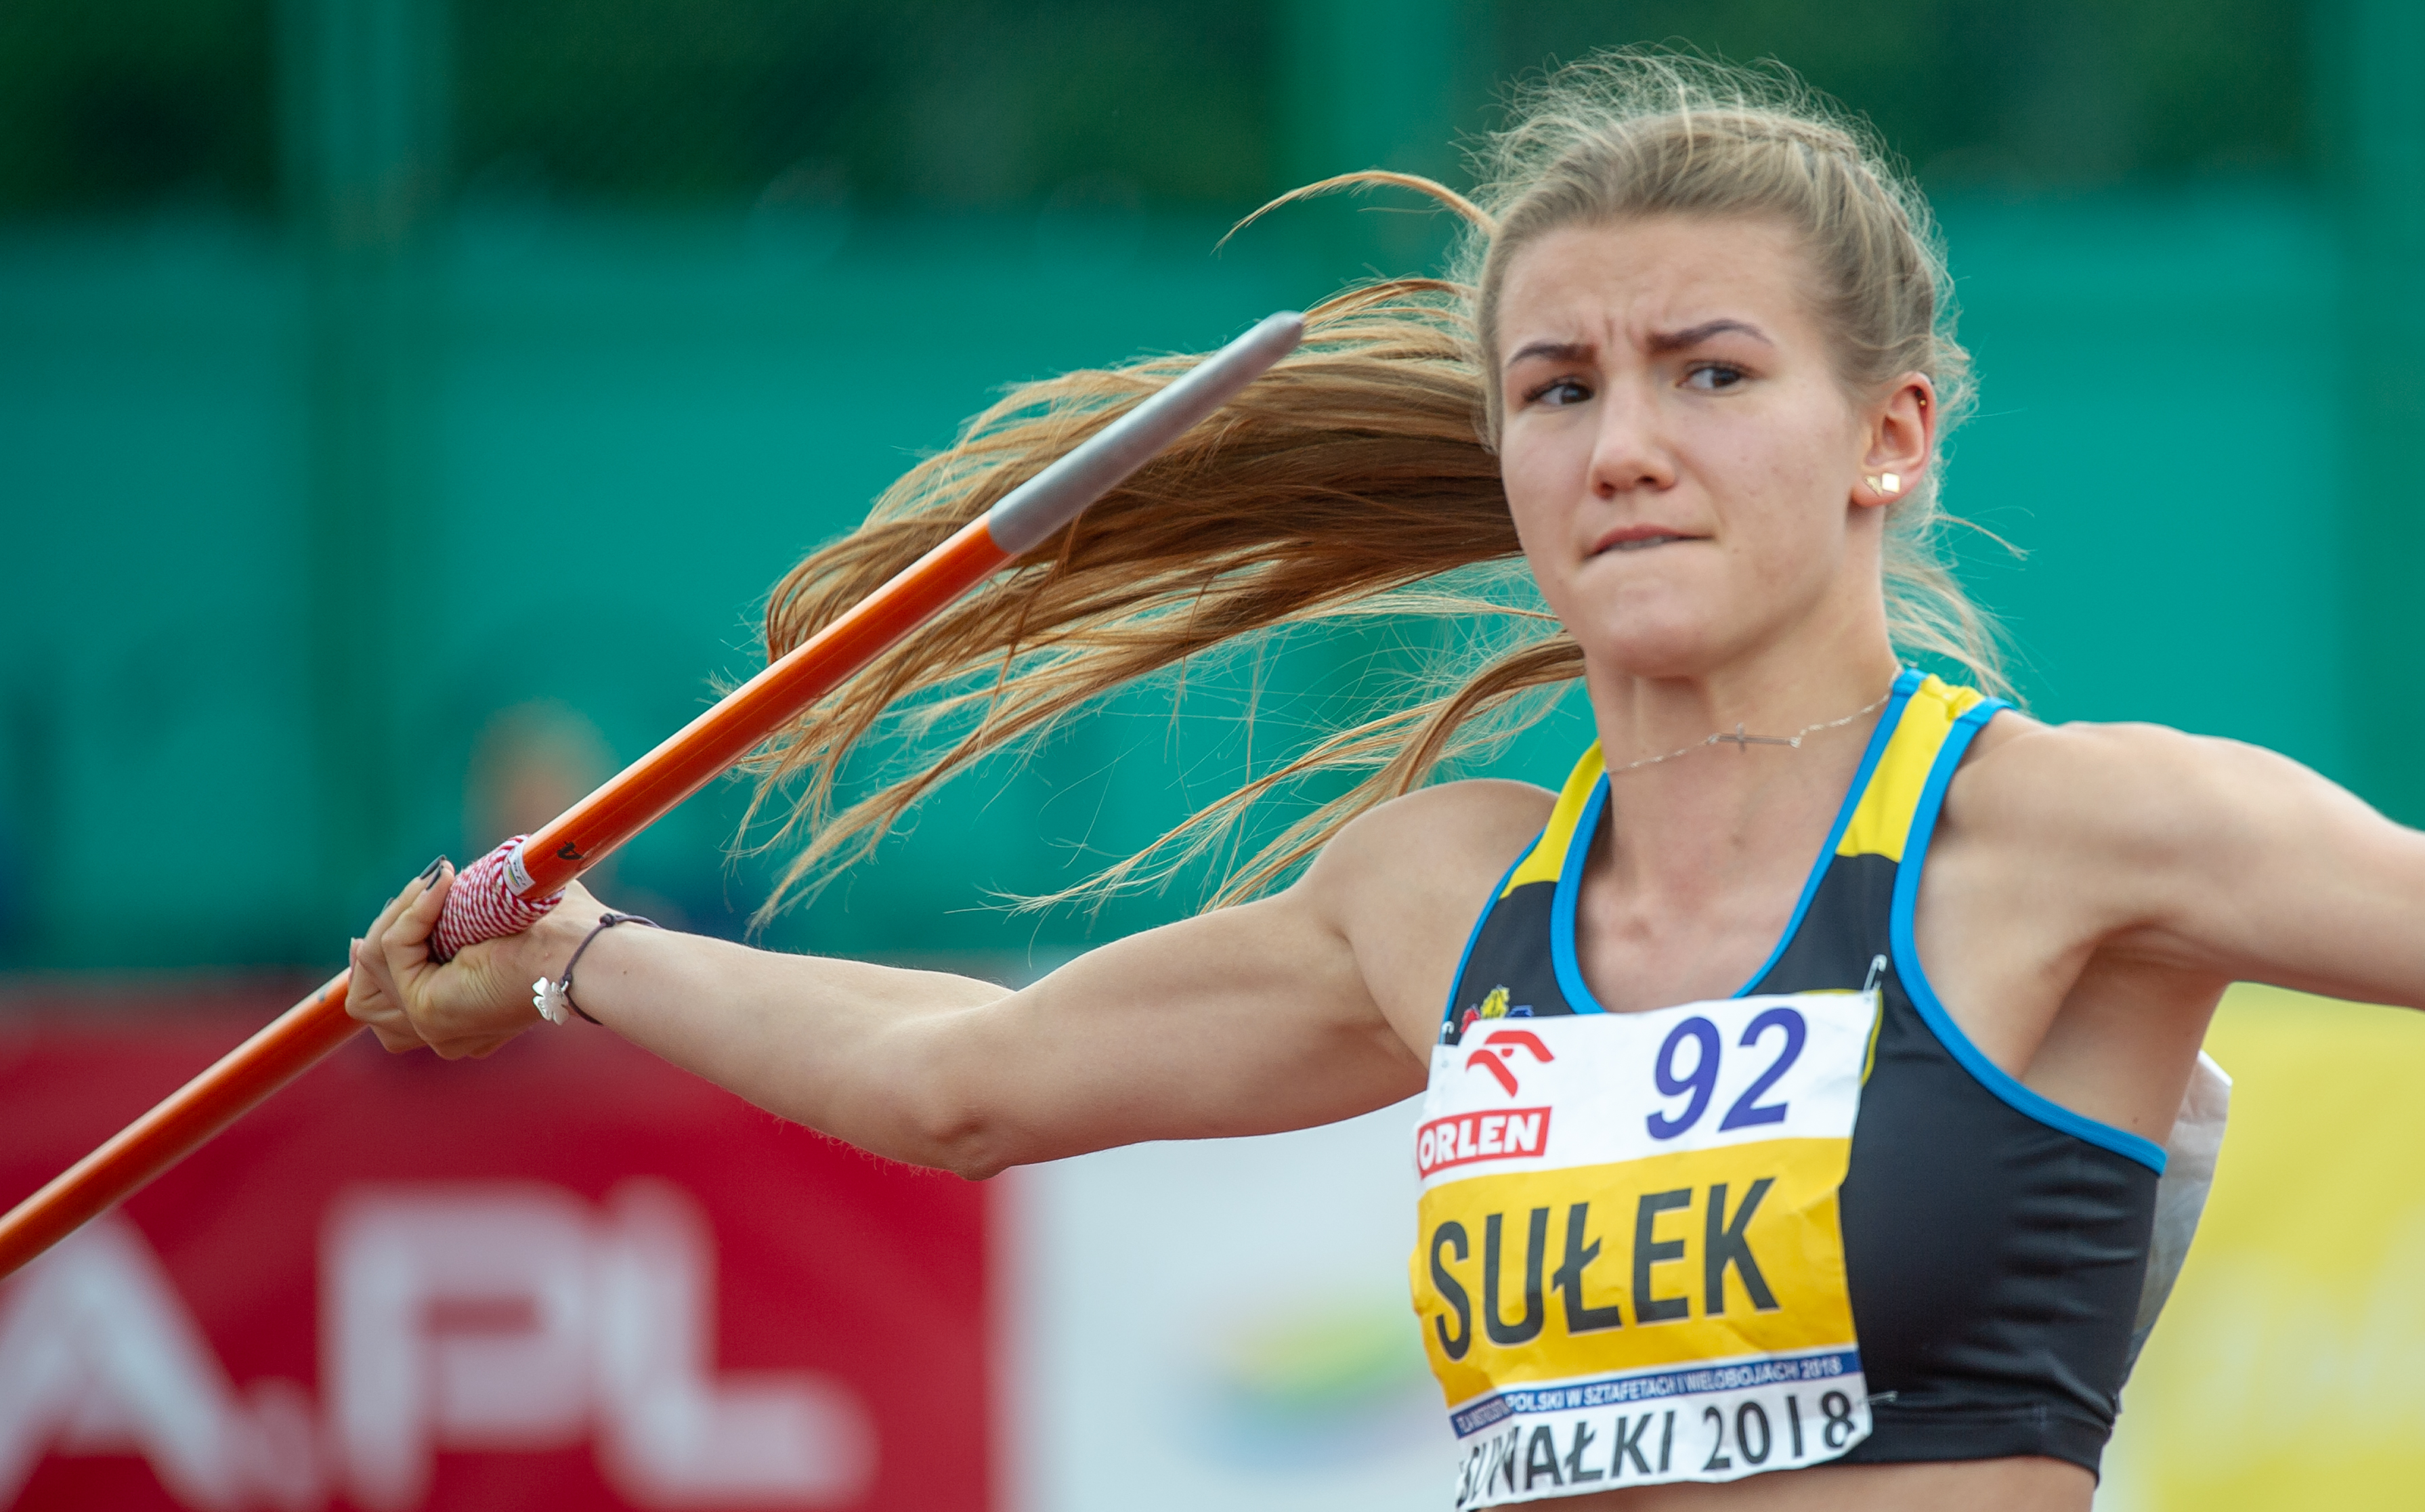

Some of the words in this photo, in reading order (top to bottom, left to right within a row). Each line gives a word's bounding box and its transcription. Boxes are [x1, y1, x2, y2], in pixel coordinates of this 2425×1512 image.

[1646, 1007, 1806, 1140] 92
[1419, 1112, 1543, 1171] ORLEN
[1430, 1177, 1782, 1362] SUŁEK
[1504, 1389, 1566, 1412] POLSKI
[1566, 1387, 1583, 1408] W
[1800, 1355, 1844, 1379] 2018
[1702, 1390, 1855, 1472] 2018
